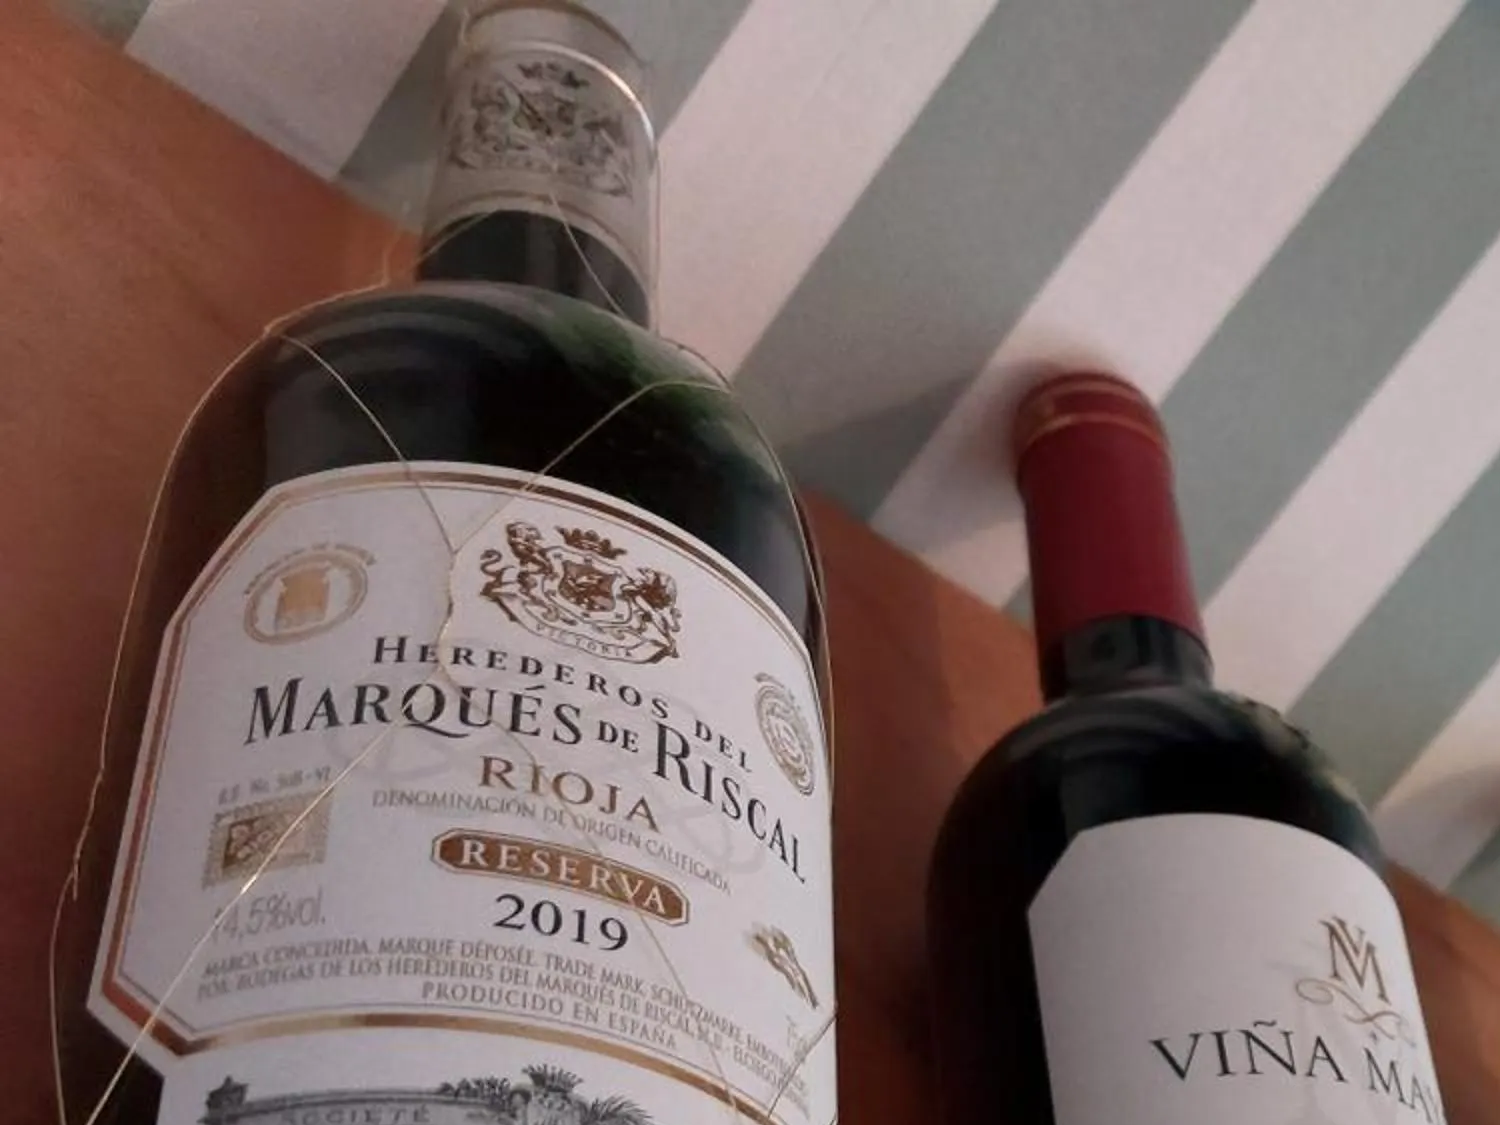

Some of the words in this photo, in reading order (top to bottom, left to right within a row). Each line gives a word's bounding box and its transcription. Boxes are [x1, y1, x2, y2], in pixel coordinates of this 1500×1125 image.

[373, 635, 670, 719] HEREDEROS
[694, 718, 752, 774] DEL
[244, 677, 583, 746] MARQUÉS
[596, 719, 639, 754] DE
[652, 720, 805, 884] RISCAL
[479, 754, 661, 834] RIOJA
[372, 789, 536, 821] DENOMINACIÓN
[572, 814, 641, 850] ORIGEN
[646, 838, 732, 896] CALIFICADA
[459, 838, 667, 915] RESERVA
[493, 892, 629, 951] 2019
[320, 961, 344, 978] DE
[350, 958, 382, 976] LOS
[387, 957, 495, 981] HEREDEROS
[498, 962, 530, 986] DEL
[378, 936, 455, 957] MARQUE
[544, 953, 594, 980] TRADE
[421, 981, 564, 1016] PRODUCIDO
[573, 1000, 599, 1026] EN
[608, 1010, 677, 1049] ESPAÑA
[1149, 1019, 1348, 1083] VIÑA
